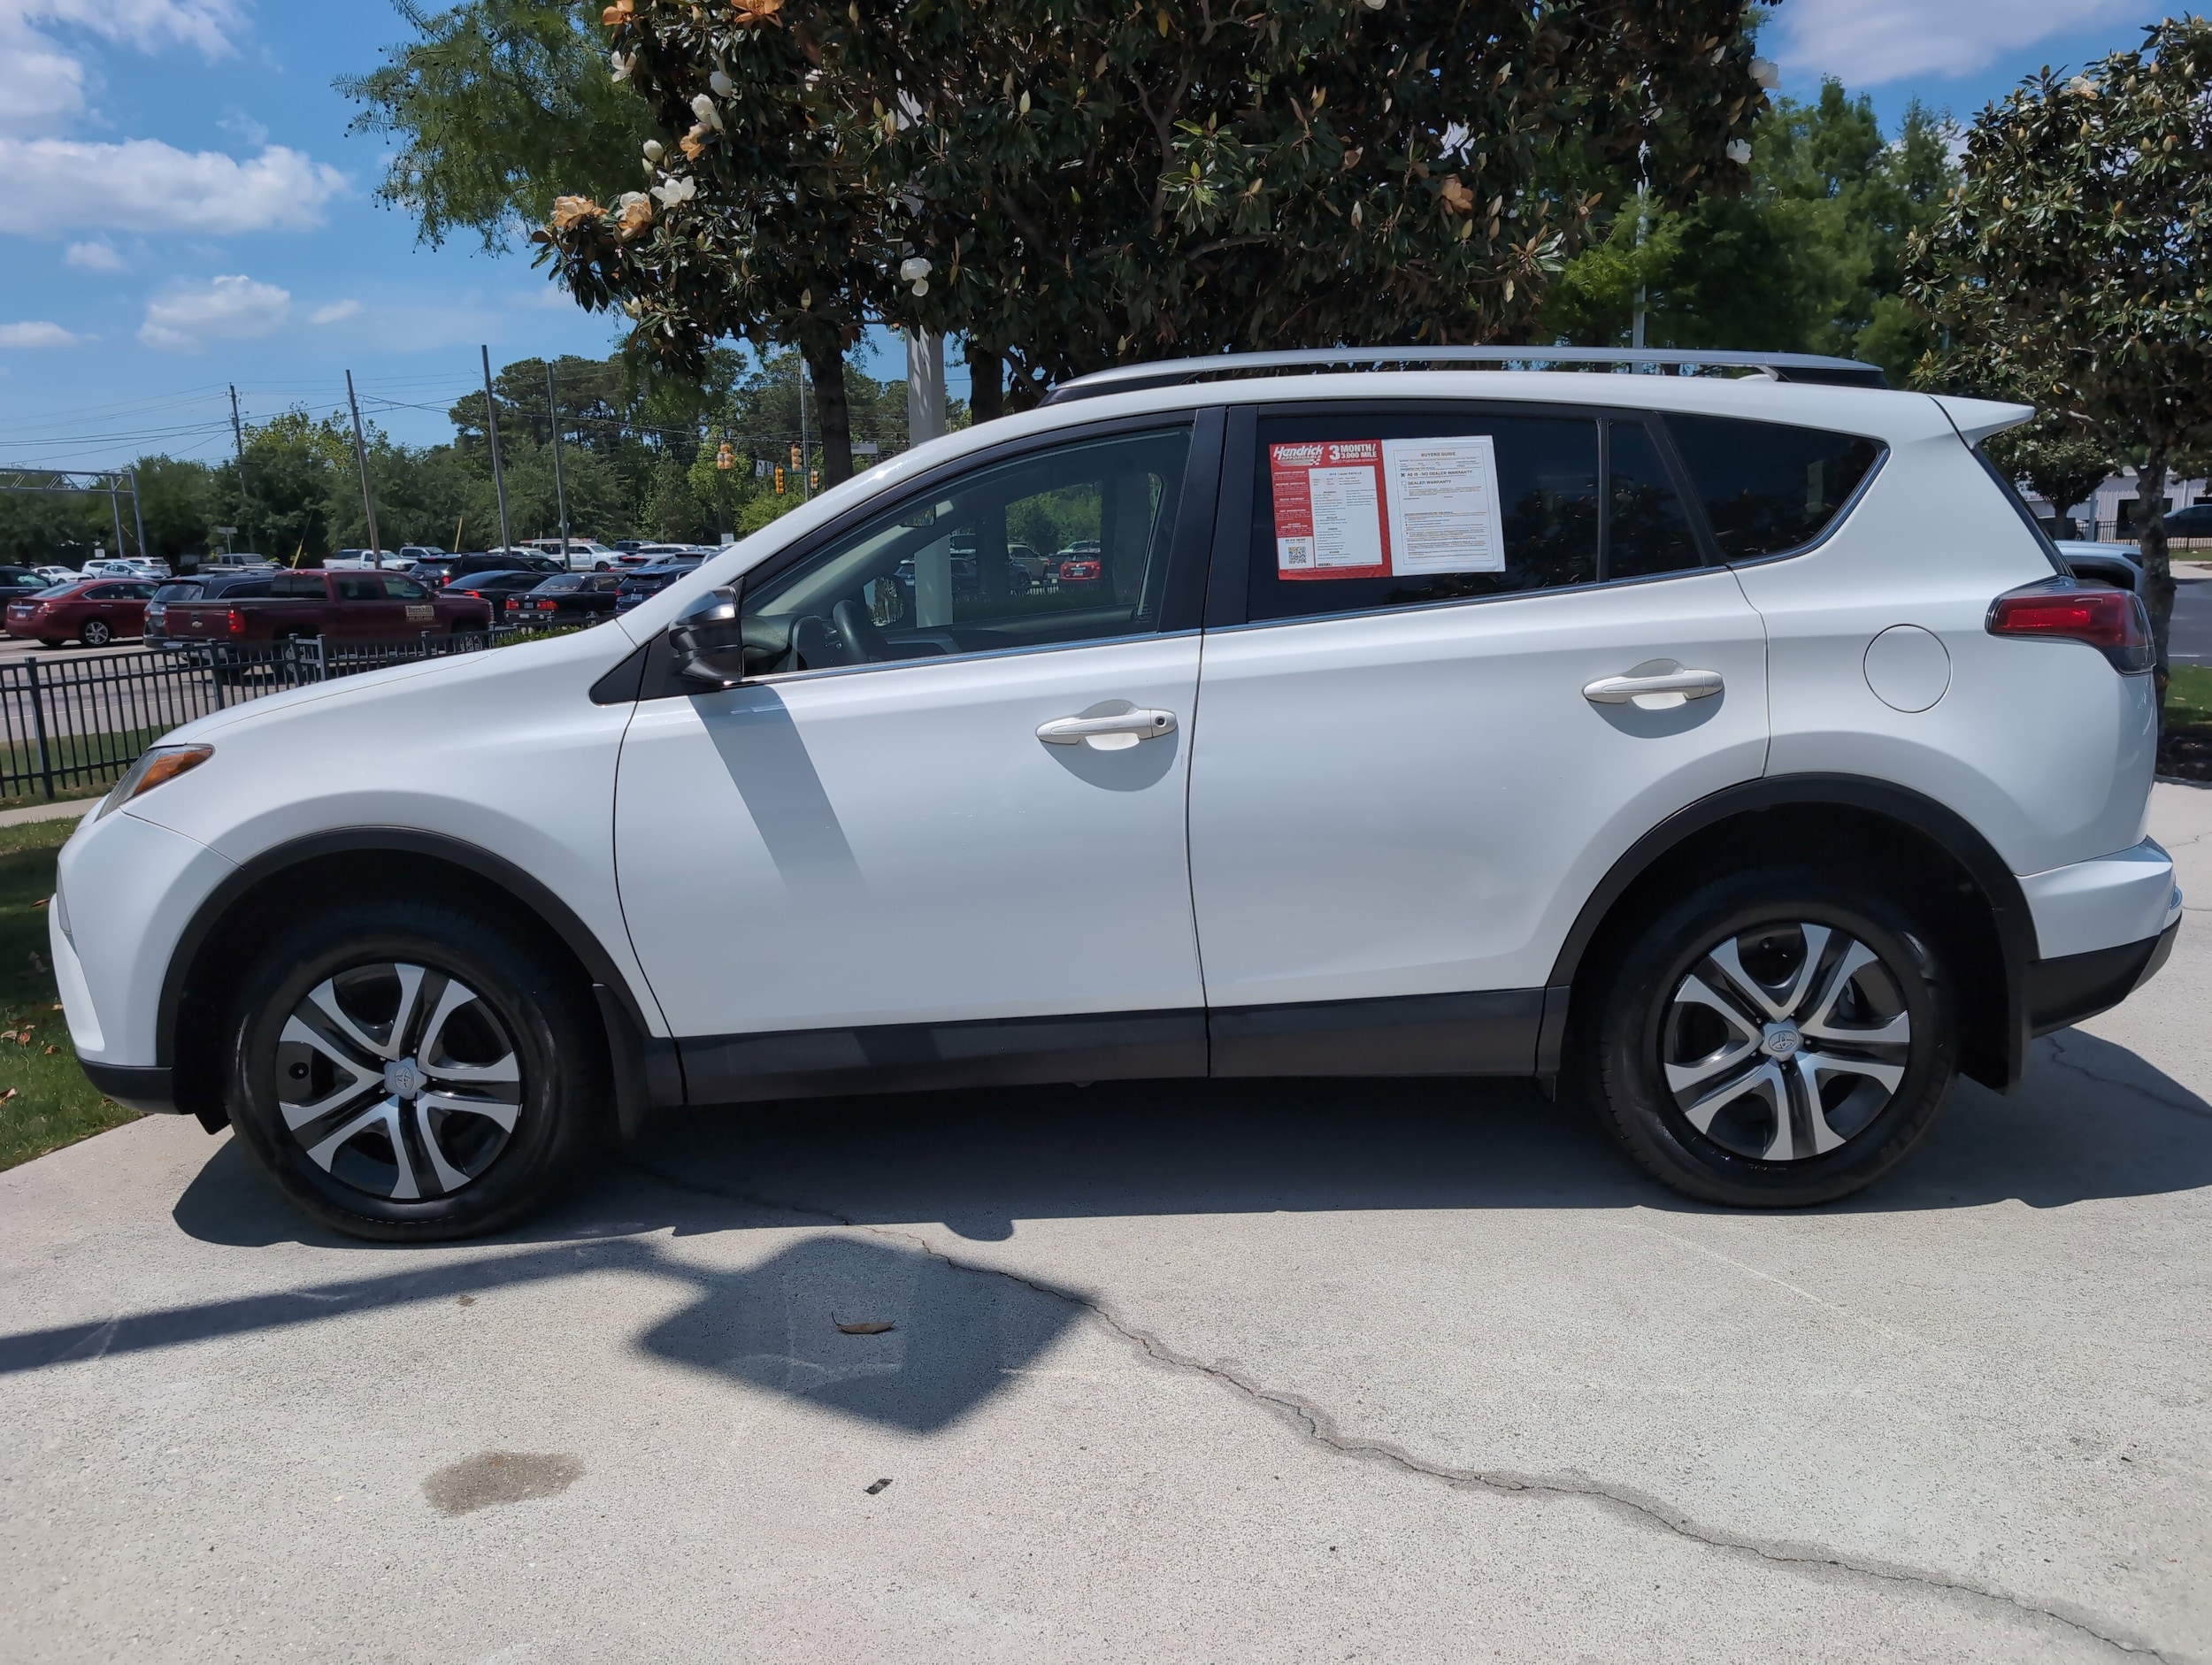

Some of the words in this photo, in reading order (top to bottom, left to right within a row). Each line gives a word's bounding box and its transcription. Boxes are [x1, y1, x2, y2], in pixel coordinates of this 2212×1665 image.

[1273, 444, 1324, 460] Hendrick
[1329, 445, 1340, 461] 3
[1340, 443, 1377, 453] MONTH/
